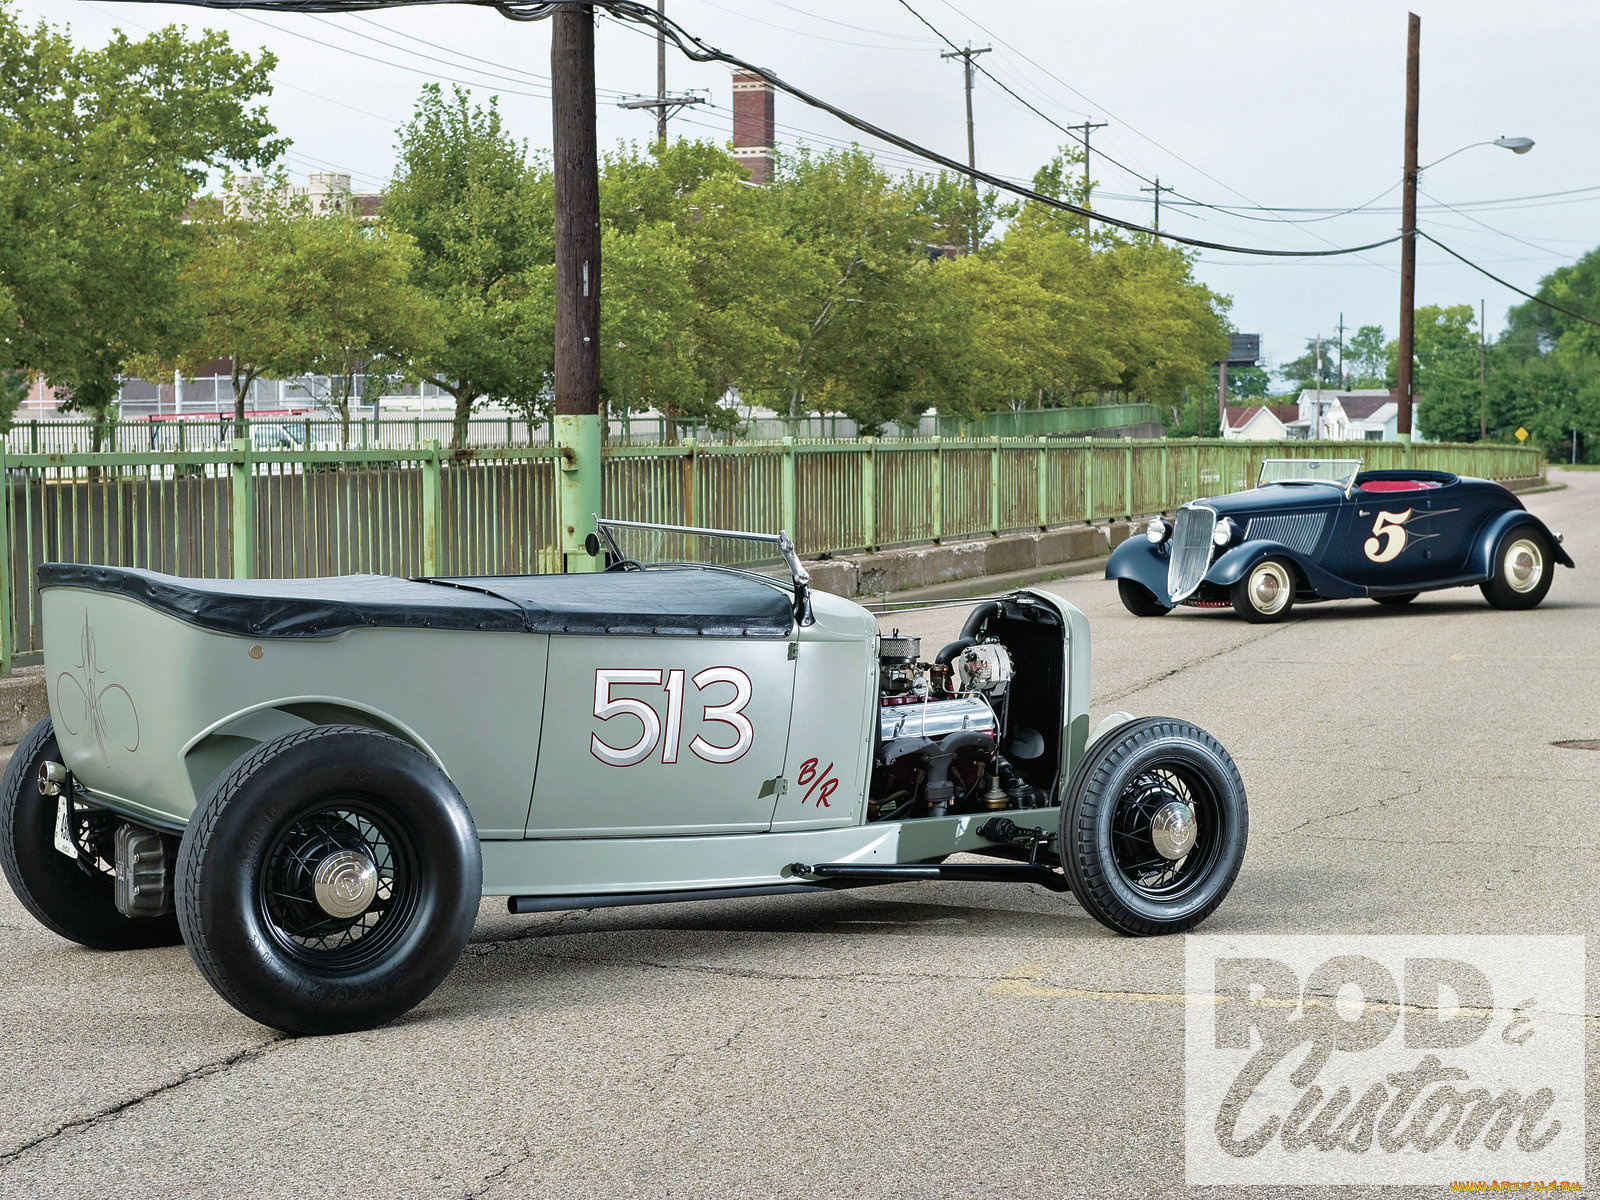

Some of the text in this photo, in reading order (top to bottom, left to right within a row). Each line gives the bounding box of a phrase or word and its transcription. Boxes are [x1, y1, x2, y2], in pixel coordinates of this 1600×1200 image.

[1364, 507, 1413, 563] 5
[590, 666, 754, 767] 513
[797, 757, 839, 809] B/R
